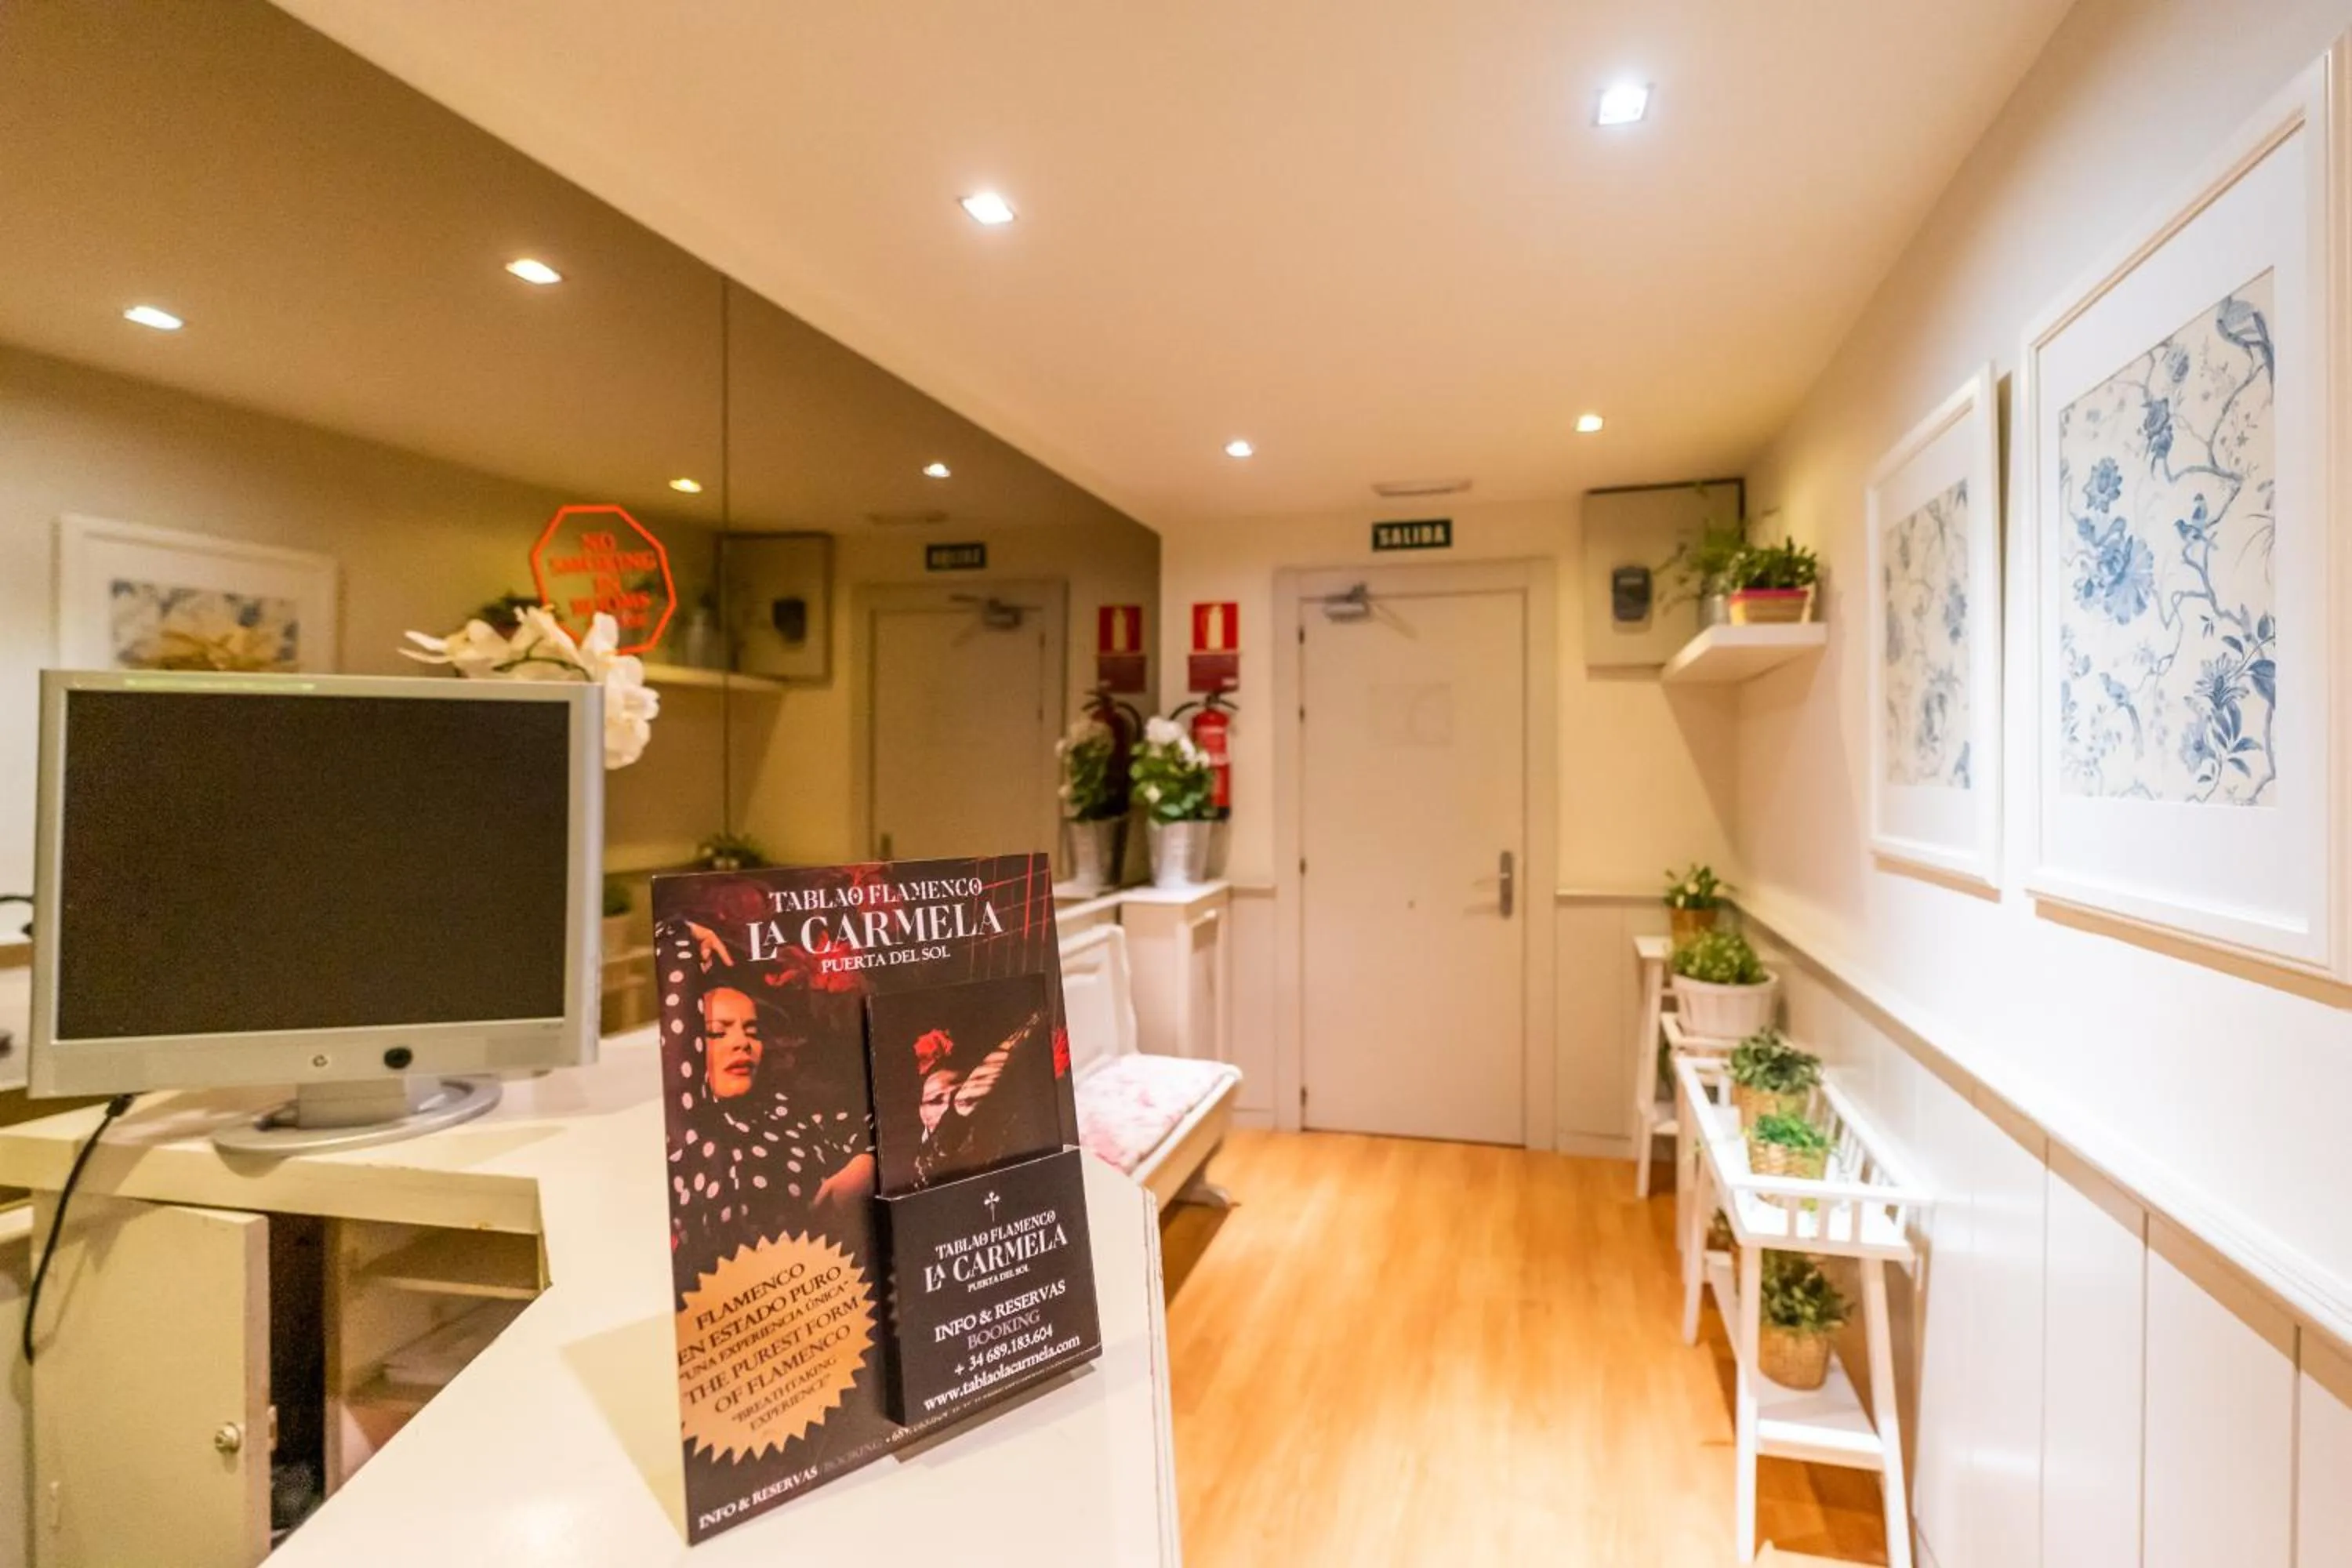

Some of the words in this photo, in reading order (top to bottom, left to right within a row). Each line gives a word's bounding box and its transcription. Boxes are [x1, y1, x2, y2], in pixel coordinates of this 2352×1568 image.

[1378, 524, 1444, 546] SALIDA
[769, 887, 862, 913] TABLAO
[869, 877, 982, 904] FLAMENCO
[746, 920, 787, 961] LA
[800, 902, 1004, 954] CARMELA
[822, 954, 887, 973] PUERTA
[890, 950, 920, 964] DEL
[921, 946, 950, 960] SOL
[924, 1264, 946, 1293] LA
[953, 1223, 1068, 1282] CARMELA
[935, 1232, 988, 1260] TABLAO
[991, 1210, 1055, 1243] FLAMENCO
[696, 1263, 805, 1330] FLAMENCO
[967, 1276, 1000, 1292] PUERTA
[1000, 1270, 1014, 1283] DEL
[1014, 1265, 1029, 1277] SOL
[678, 1340, 706, 1367] EN
[709, 1296, 787, 1348] ESTADO
[789, 1266, 841, 1303] PURO
[719, 1308, 804, 1363] EXPERIENCIA
[935, 1315, 976, 1342] INFO
[980, 1310, 993, 1327] &
[995, 1279, 1065, 1319] RESERVAS
[967, 1309, 1040, 1350] BOOKING
[685, 1377, 731, 1405] THE
[731, 1329, 803, 1380] PUREST
[805, 1296, 858, 1334] FORM
[715, 1390, 742, 1413] OF
[747, 1325, 851, 1395] FLAMENCO
[924, 1335, 1080, 1411] www.tablaolacarmela.com
[954, 1363, 965, 1376] +
[968, 1351, 984, 1371] 34
[986, 1323, 1053, 1363] 689.183.604
[699, 1503, 735, 1529] INFO
[738, 1497, 750, 1512] &
[752, 1465, 818, 1506] RESERVAS
